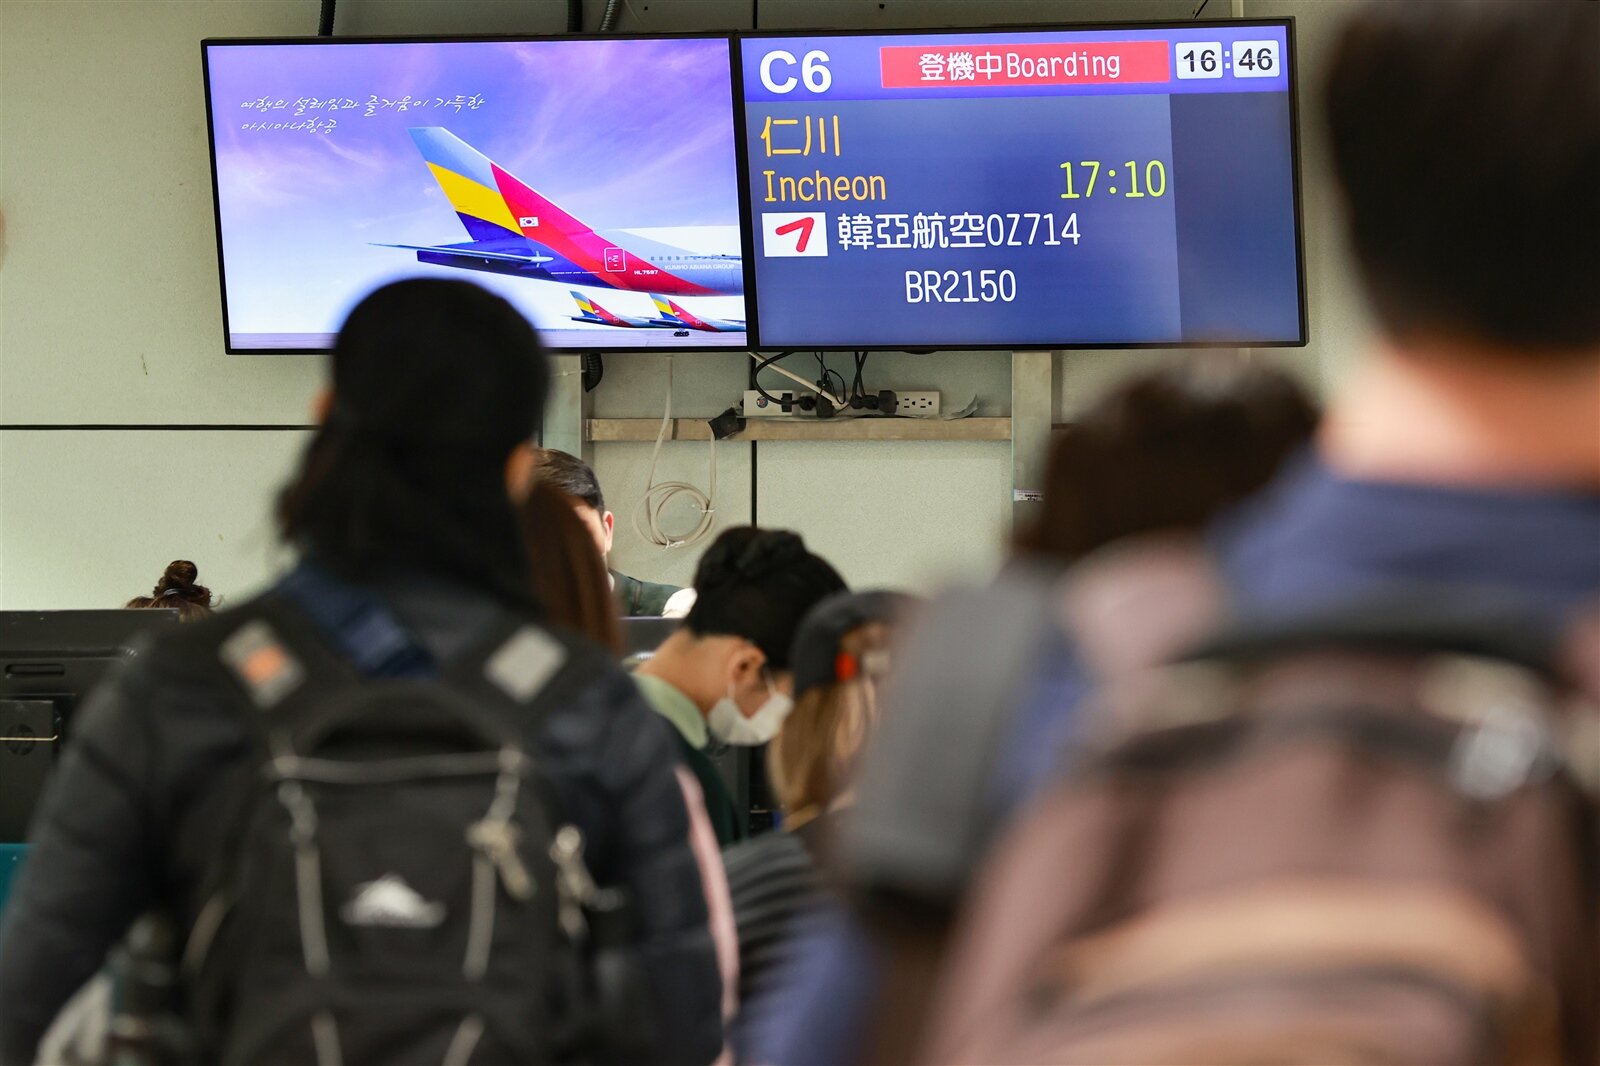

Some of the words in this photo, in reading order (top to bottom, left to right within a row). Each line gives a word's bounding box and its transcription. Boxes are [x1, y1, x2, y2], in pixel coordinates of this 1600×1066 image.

[759, 50, 832, 94] C6
[1183, 48, 1273, 73] 16:46
[240, 96, 289, 113] 여행의
[292, 97, 360, 116] 설레임과
[364, 94, 430, 117] 즐거움이
[434, 93, 486, 114] 가득한
[241, 117, 337, 134] 아시아나항공
[760, 115, 841, 158] 仁川
[763, 170, 887, 202] Incheon
[1059, 159, 1166, 199] 17:10
[905, 269, 1017, 303] BR2150
